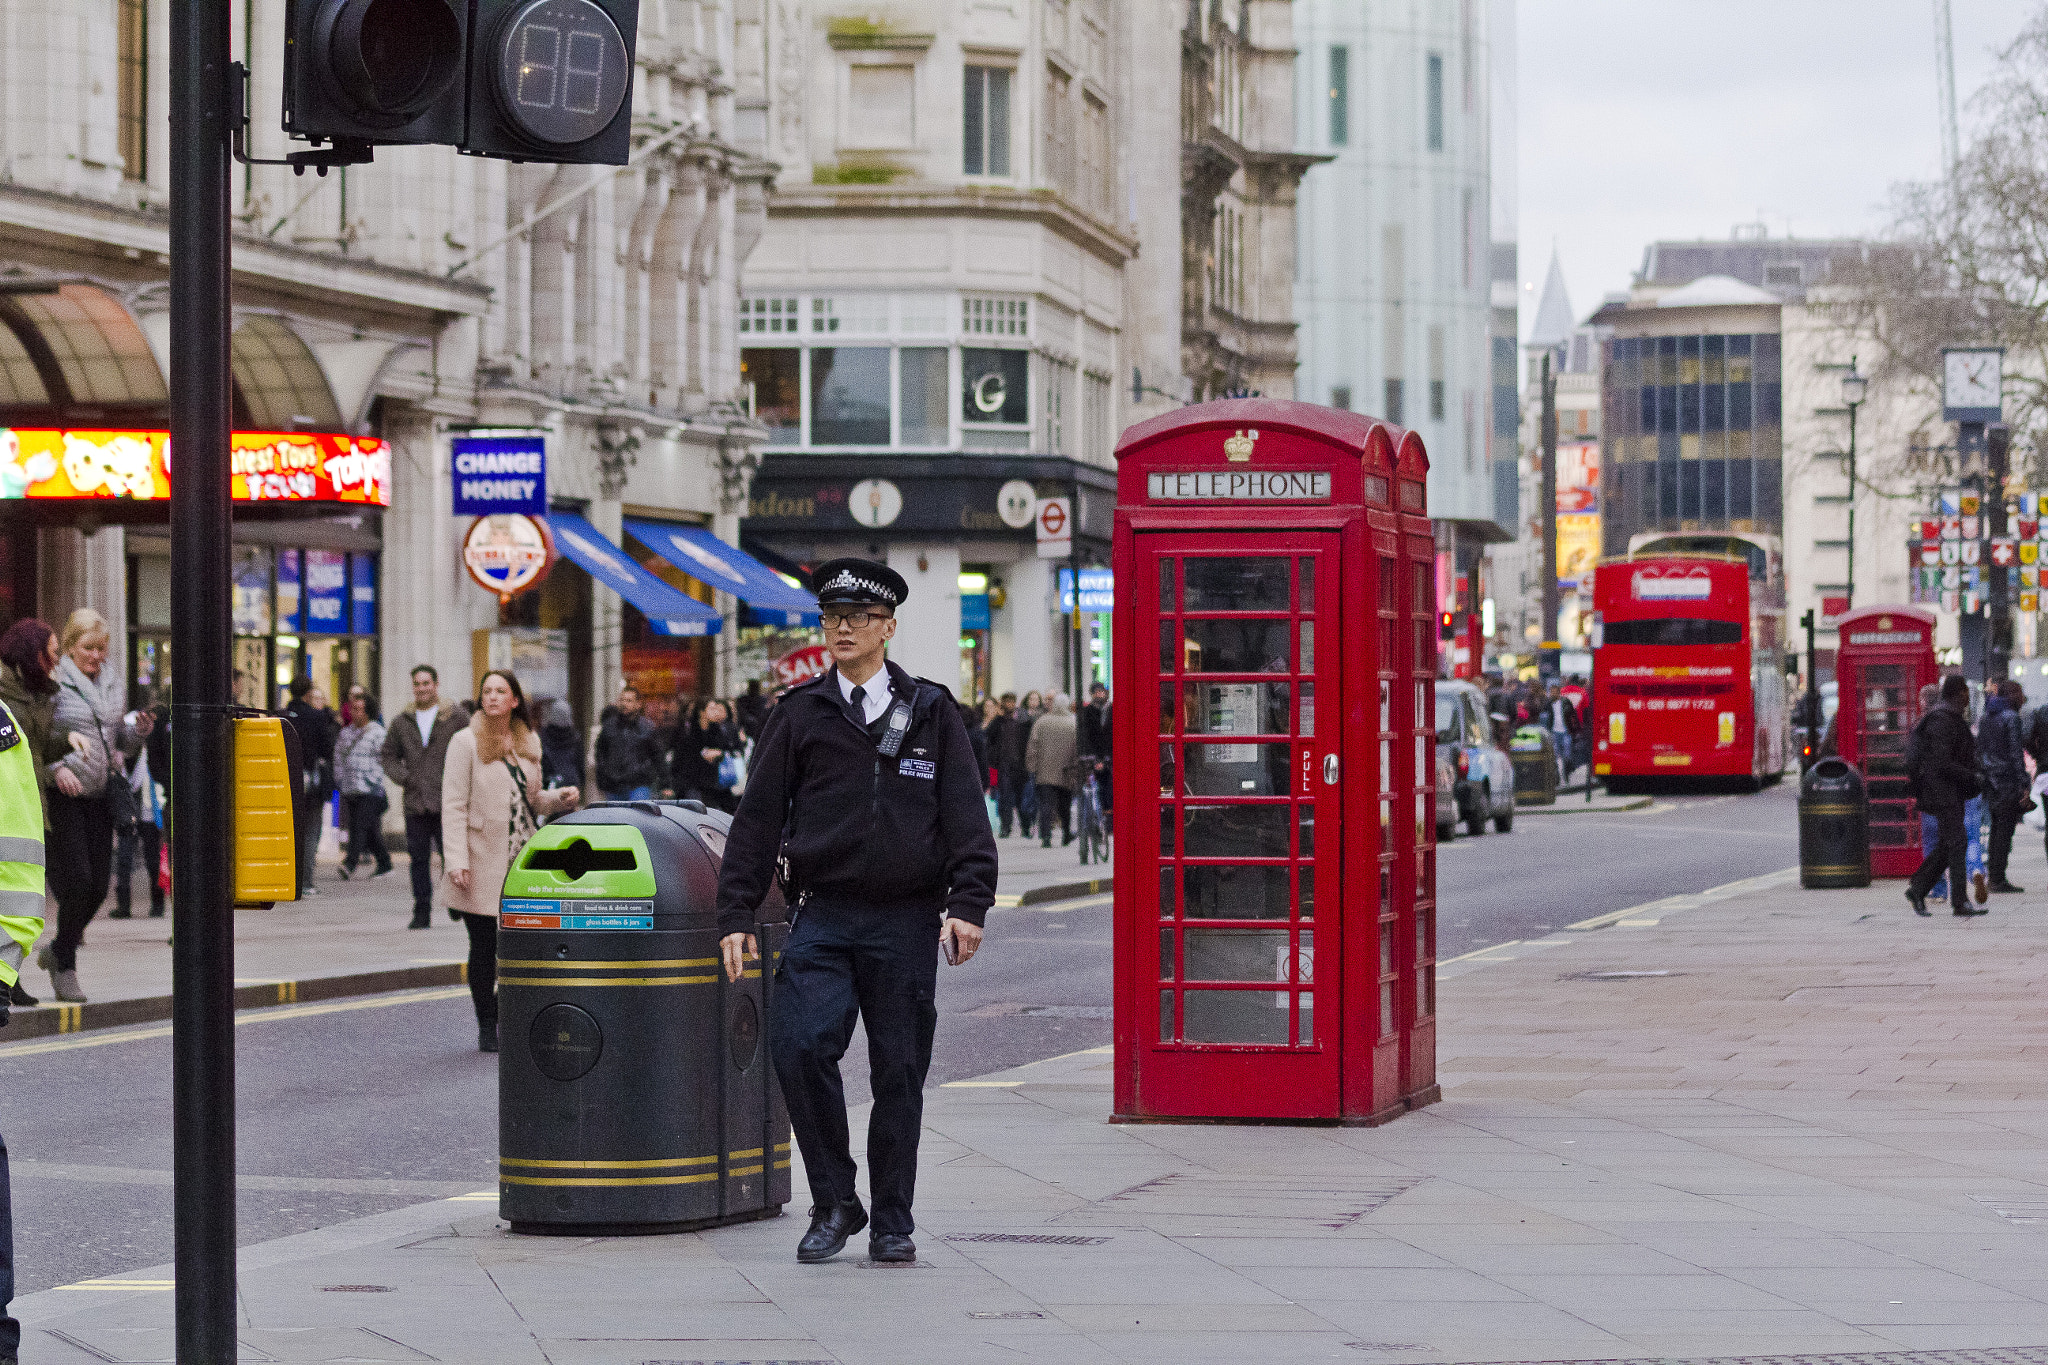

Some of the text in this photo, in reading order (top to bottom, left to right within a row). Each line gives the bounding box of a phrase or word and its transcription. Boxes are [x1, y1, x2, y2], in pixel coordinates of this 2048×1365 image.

[455, 452, 542, 474] CHANGE
[461, 479, 537, 500] MONEY
[1157, 473, 1325, 497] TELEPHONE
[916, 771, 934, 779] OFFICER
[527, 886, 541, 894] Help
[586, 918, 601, 926] glass
[629, 918, 640, 926] jars
